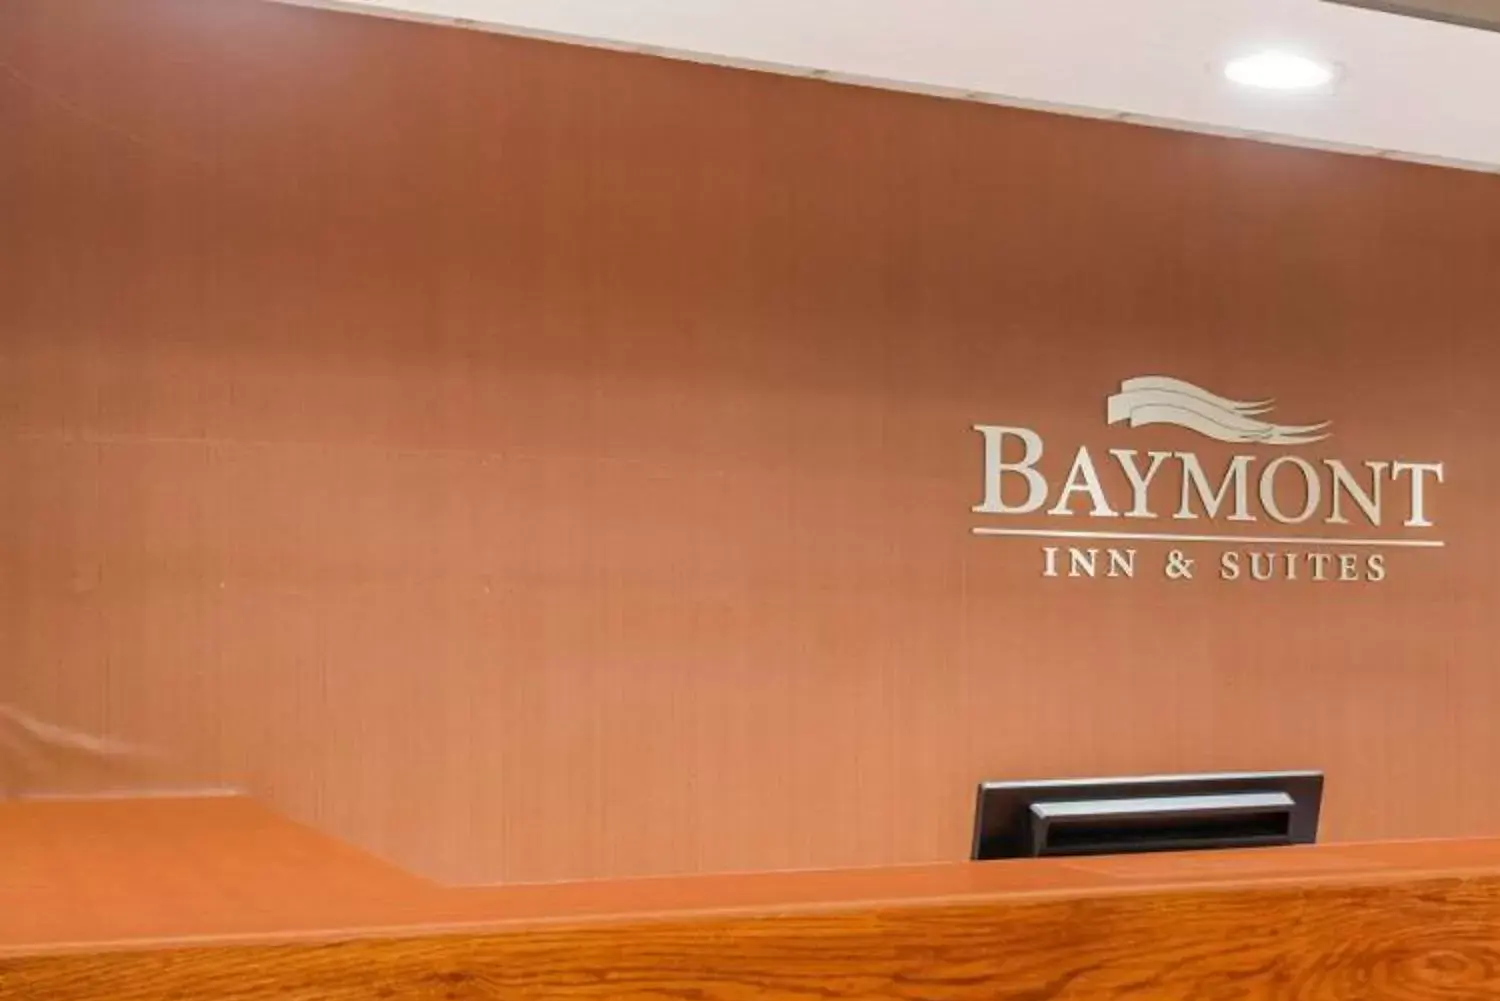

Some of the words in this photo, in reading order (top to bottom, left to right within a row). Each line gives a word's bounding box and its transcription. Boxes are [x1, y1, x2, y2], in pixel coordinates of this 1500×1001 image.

[972, 424, 1444, 527] BAYMONT
[1043, 546, 1137, 578] INN
[1165, 550, 1194, 580] &
[1221, 551, 1386, 582] SUITES
